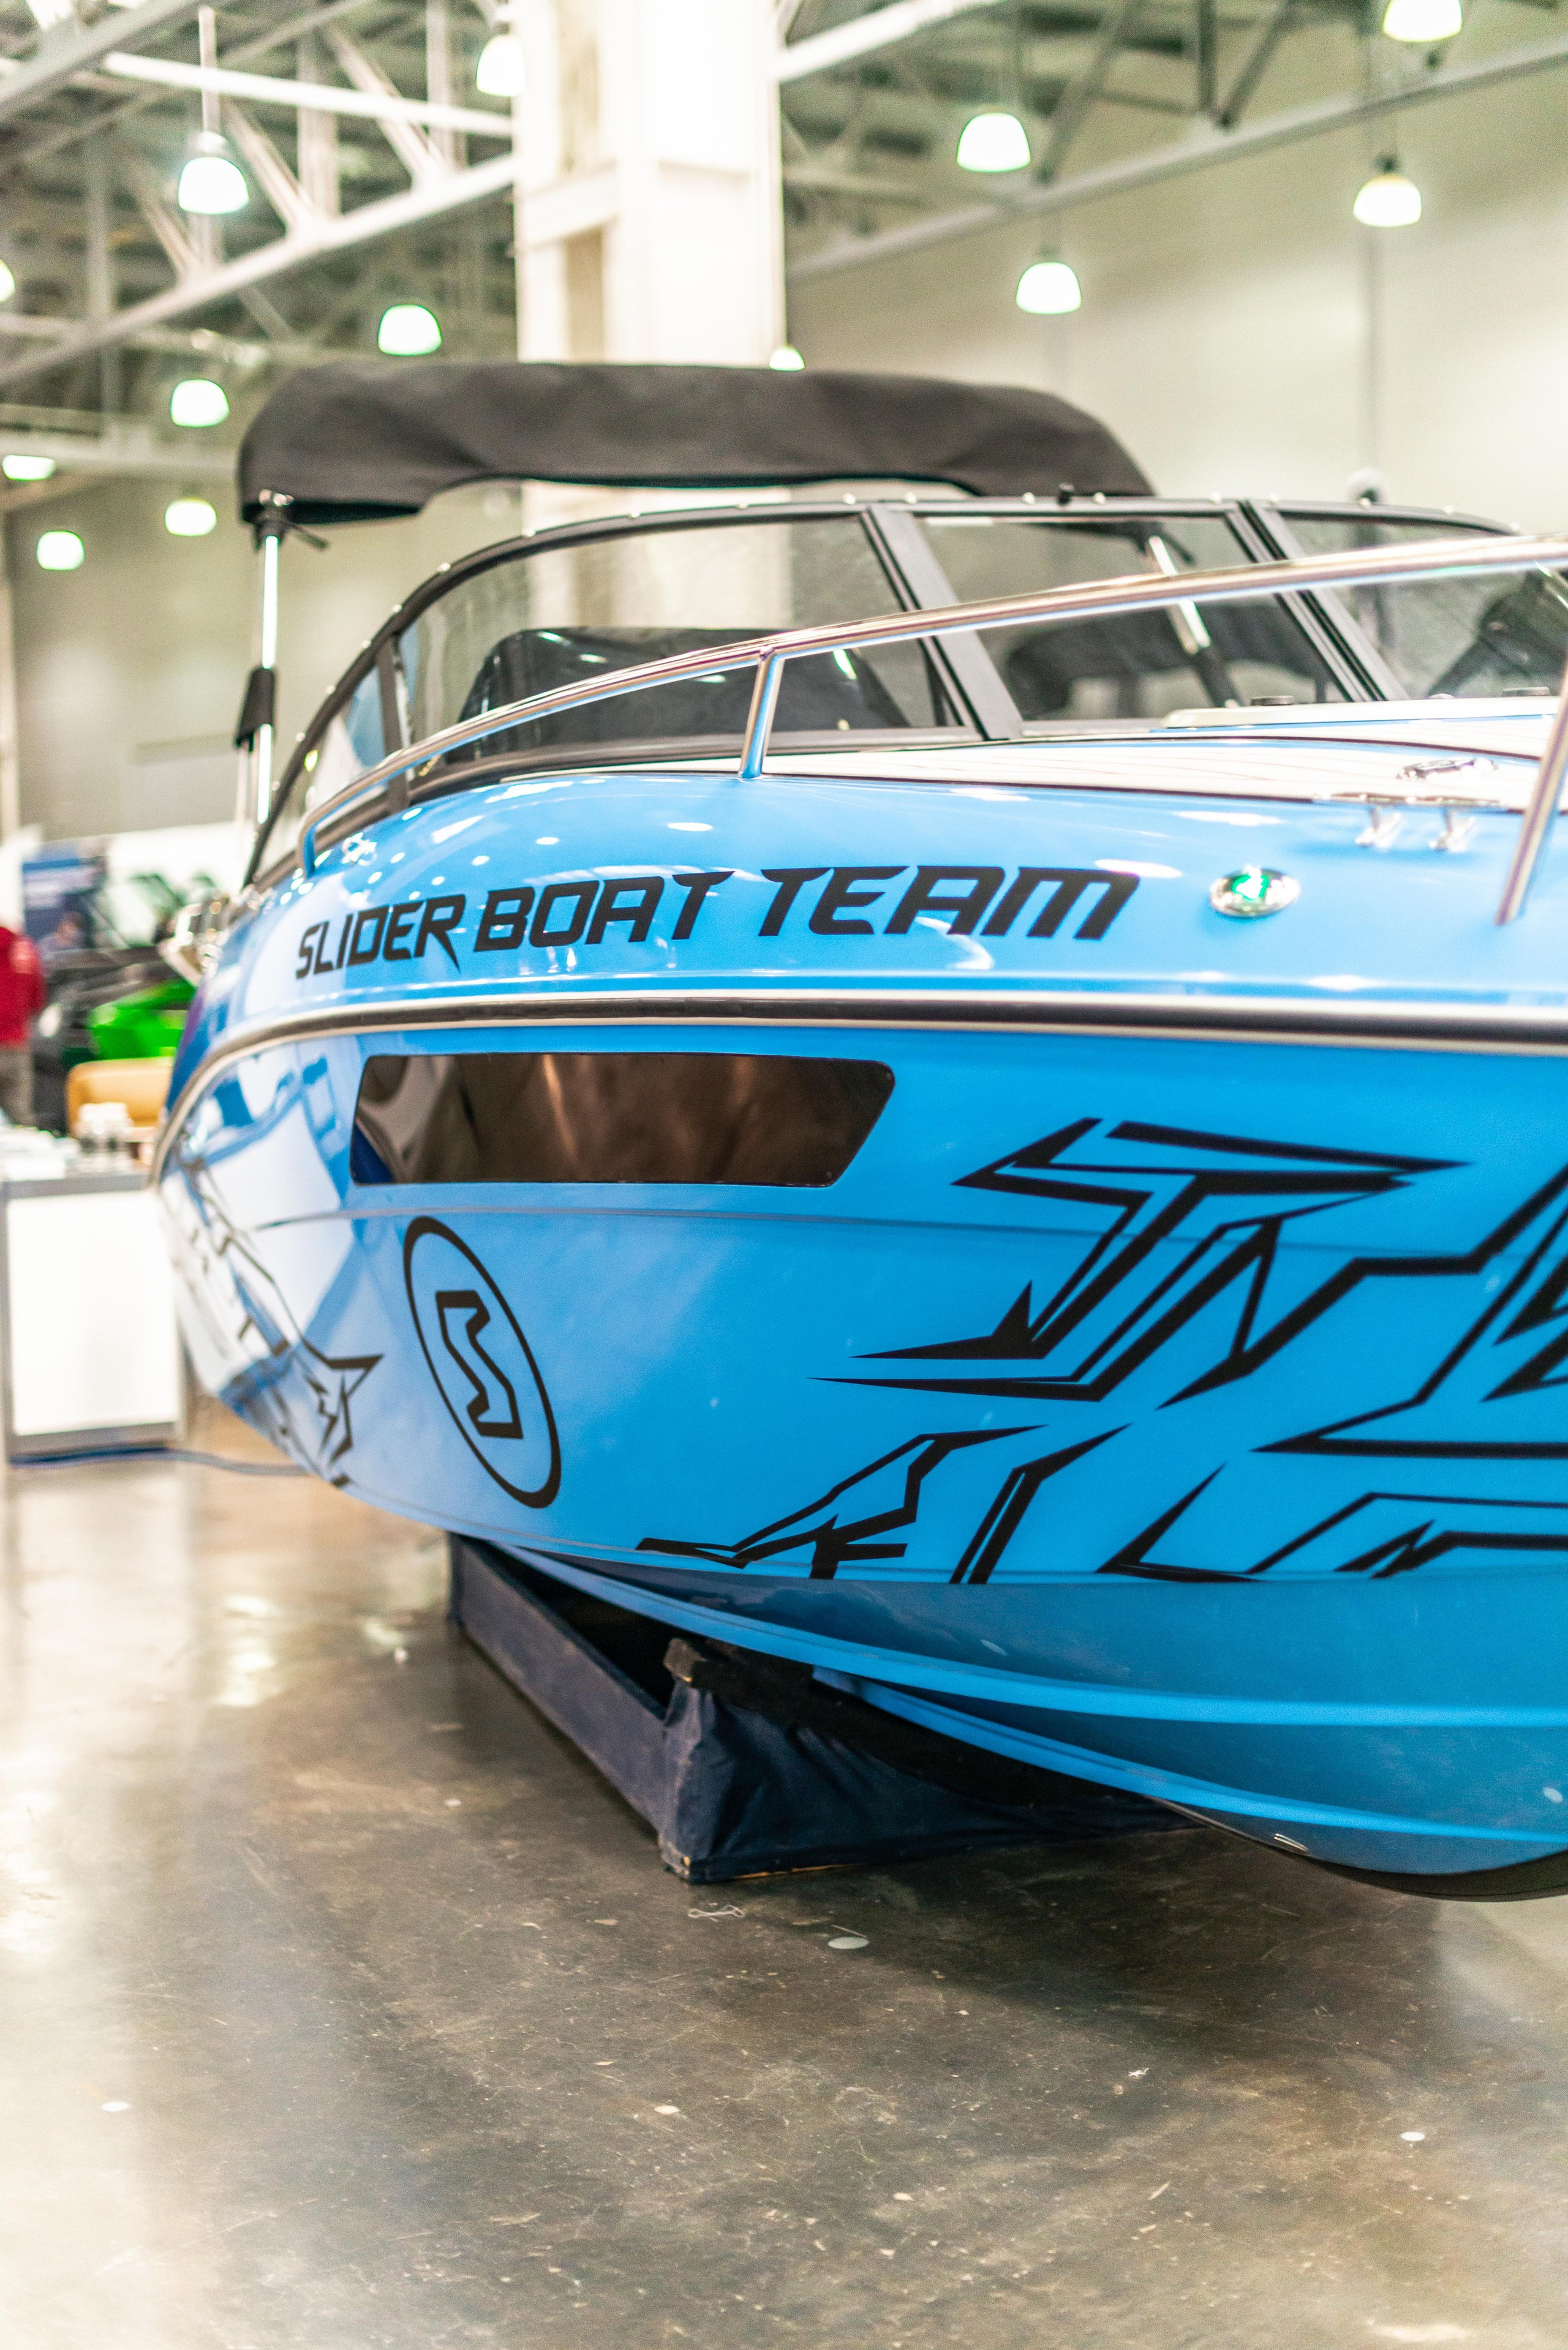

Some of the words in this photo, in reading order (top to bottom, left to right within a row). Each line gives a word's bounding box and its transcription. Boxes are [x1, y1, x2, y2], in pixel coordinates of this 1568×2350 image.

[296, 894, 466, 979] SLIDER
[473, 870, 735, 953] BOAT
[758, 865, 1140, 940] TEAM
